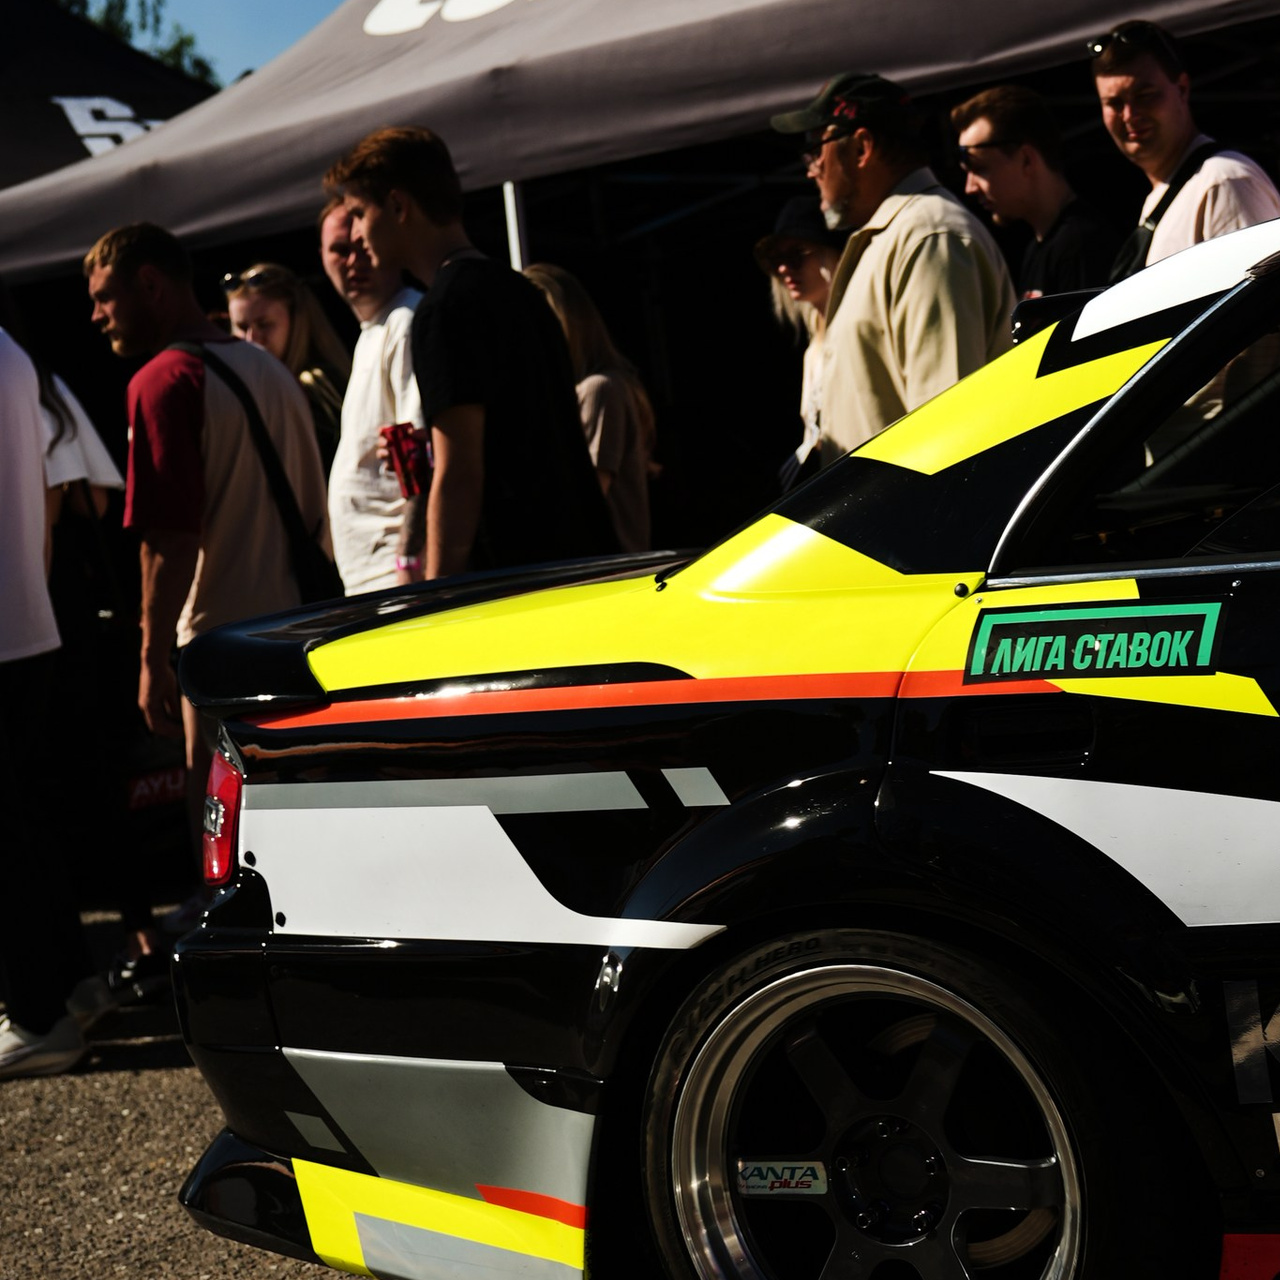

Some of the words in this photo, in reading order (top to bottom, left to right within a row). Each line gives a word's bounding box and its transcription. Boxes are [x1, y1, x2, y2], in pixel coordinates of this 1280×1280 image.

[990, 635, 1067, 674] ЛИГА
[1072, 629, 1195, 671] СТАВОК
[769, 1179, 811, 1191] plus
